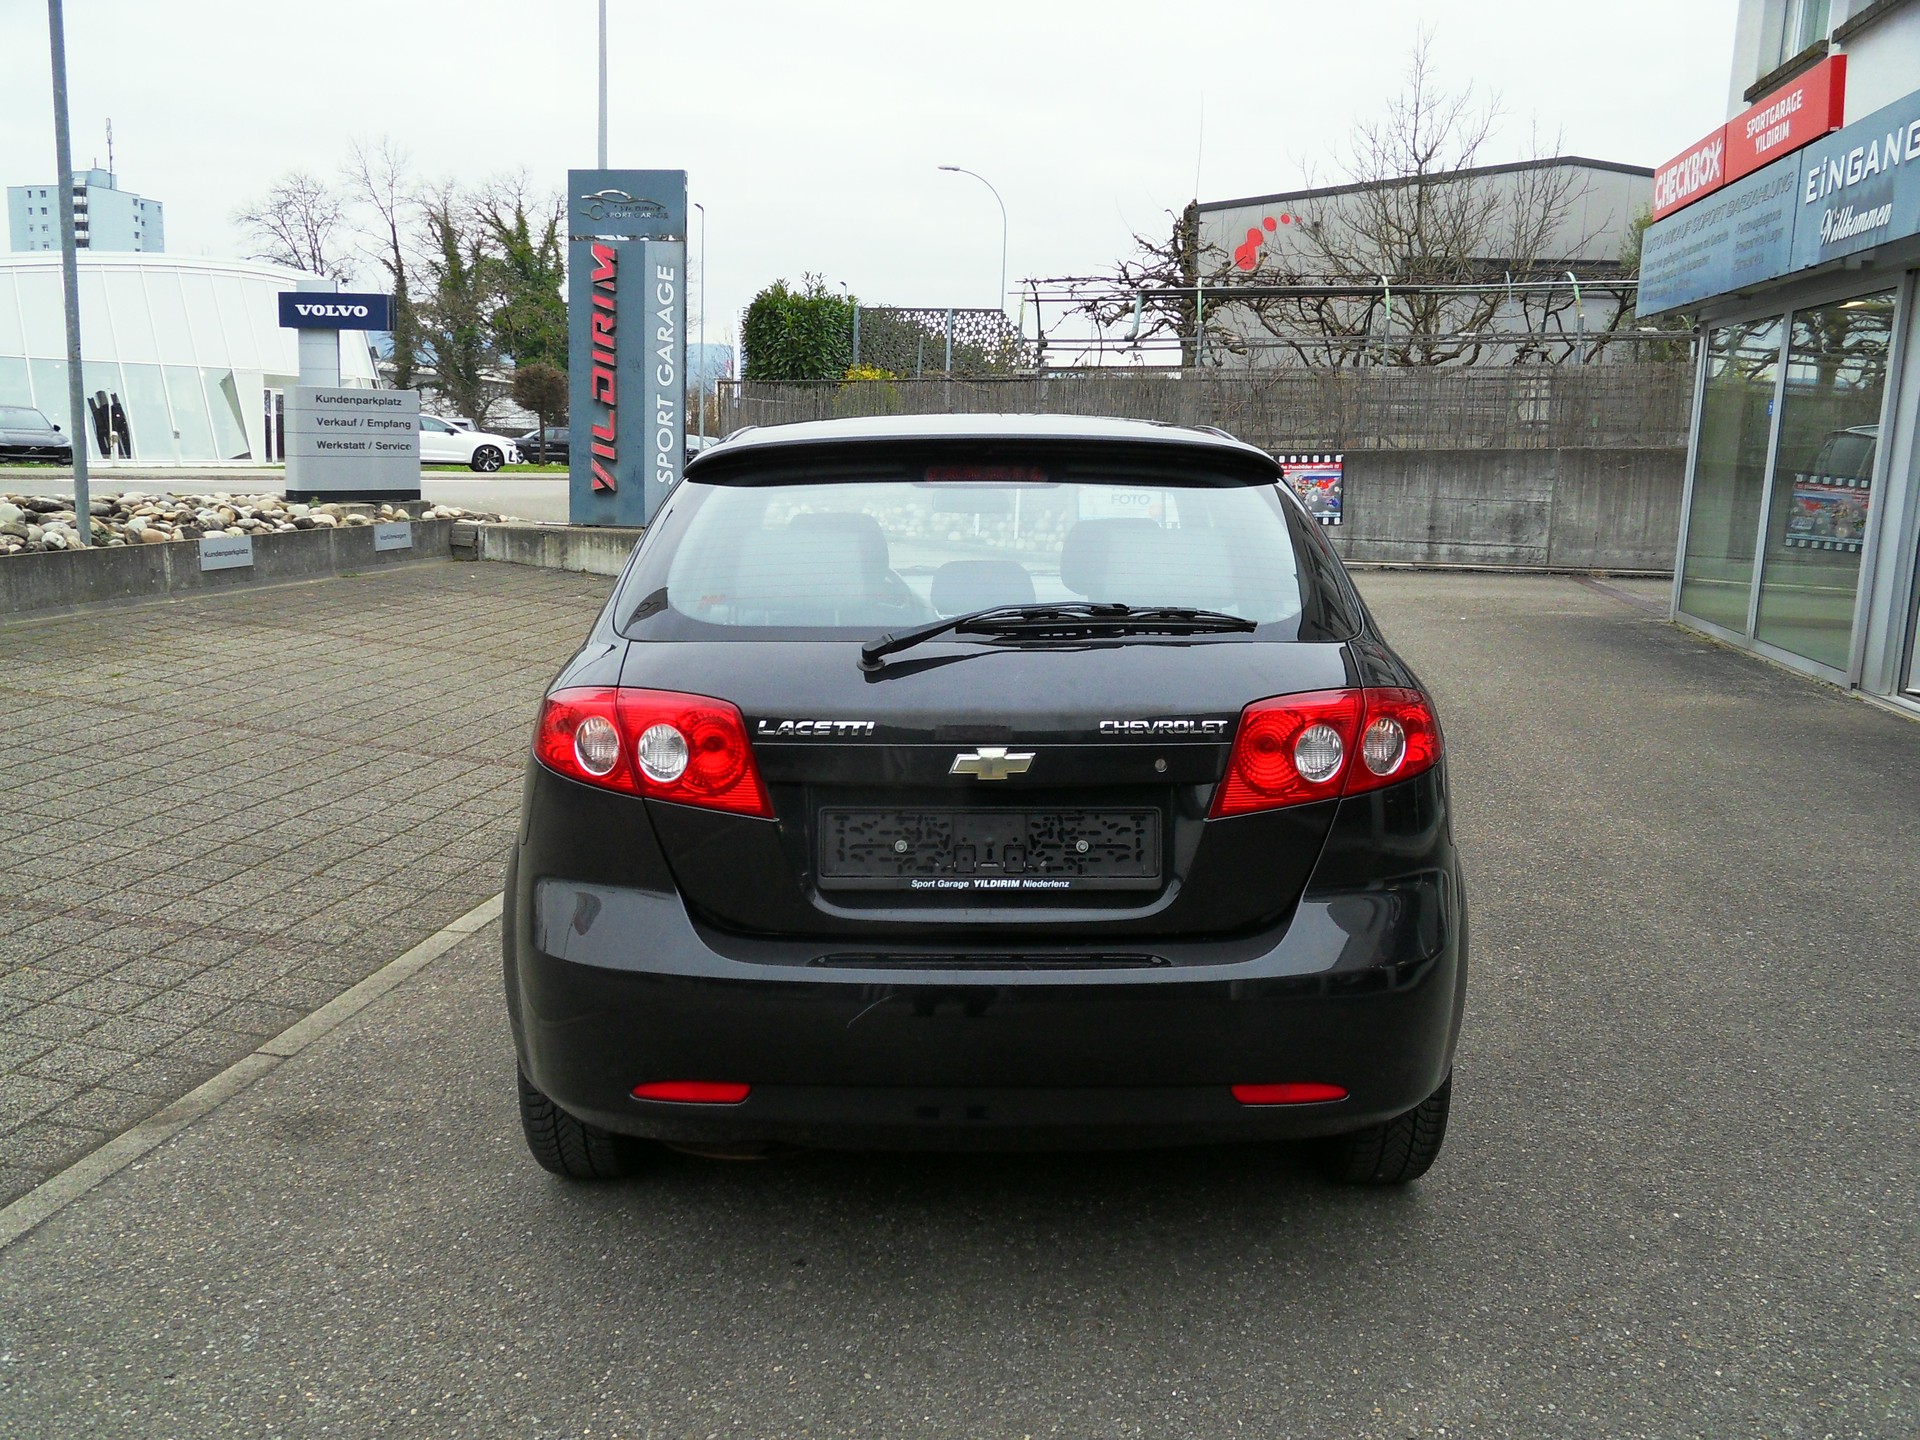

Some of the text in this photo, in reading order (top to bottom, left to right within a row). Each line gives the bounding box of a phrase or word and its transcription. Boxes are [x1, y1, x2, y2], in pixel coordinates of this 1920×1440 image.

[1746, 89, 1803, 139] SPORTGARAGE
[1755, 120, 1790, 154] YILDIRIM
[1654, 137, 1723, 211] CHECKBOX
[1821, 203, 1893, 247] Willkommen
[295, 304, 369, 318] VOLVO
[591, 242, 617, 495] YILDIRIM
[656, 264, 675, 486] SPORT GARAGE
[315, 394, 403, 407] Kundenparkplatz
[316, 417, 358, 428] Verkauf
[367, 418, 412, 431] Empfang
[316, 440, 366, 451] Werkstatt
[375, 442, 412, 452] Service
[1111, 493, 1150, 506] FOTO
[757, 720, 875, 736] LACETTI
[1099, 720, 1228, 735] CHEVROLET
[910, 879, 1070, 889] Sport Garage YILDIRIM Niederlenz
